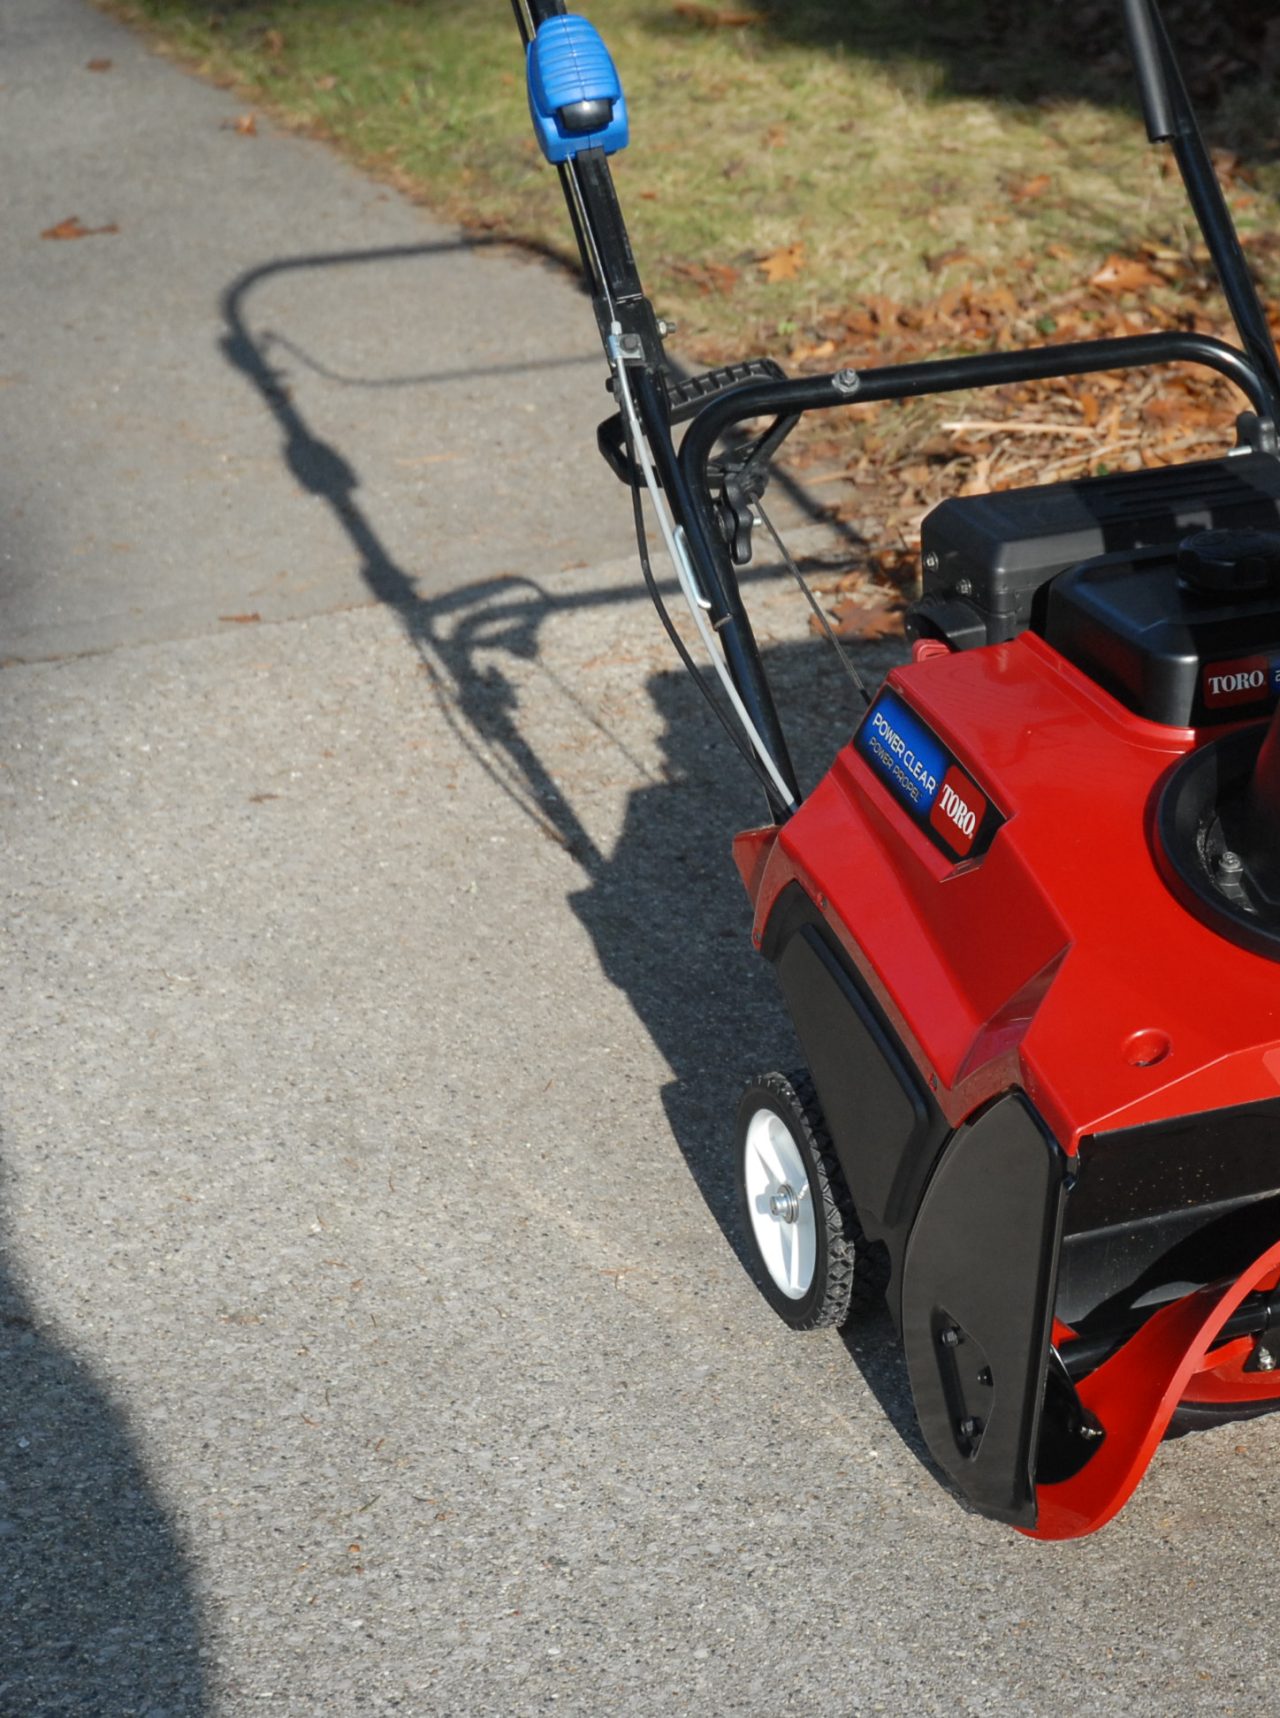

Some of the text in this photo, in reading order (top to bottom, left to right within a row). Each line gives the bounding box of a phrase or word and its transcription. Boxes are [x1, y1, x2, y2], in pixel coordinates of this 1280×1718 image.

[1208, 670, 1264, 695] TORO
[869, 736, 919, 802] POWER PROPEL
[872, 712, 936, 794] POWER CLEAR
[939, 784, 976, 835] TORO
